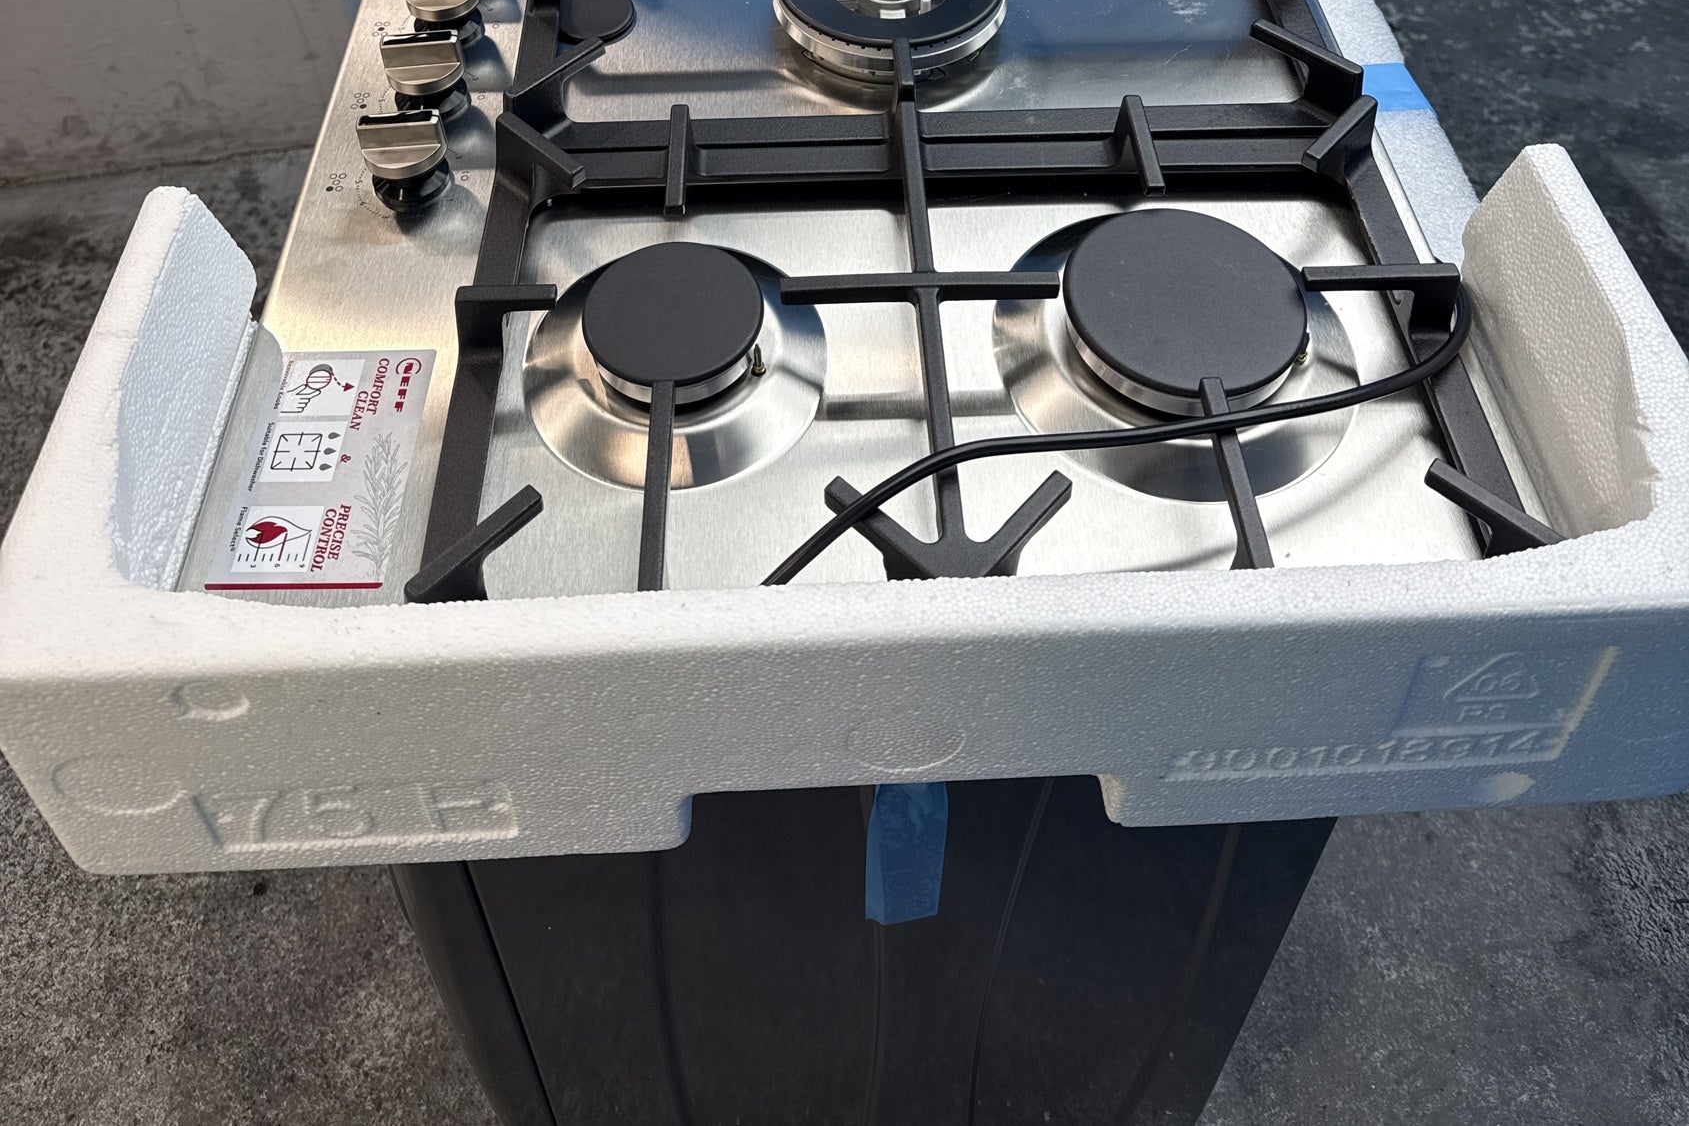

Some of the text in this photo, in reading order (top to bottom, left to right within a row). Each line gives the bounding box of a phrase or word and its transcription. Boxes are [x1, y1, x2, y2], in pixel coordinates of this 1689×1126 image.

[272, 393, 285, 410] Knobs
[349, 390, 369, 431] CLEAN
[365, 358, 390, 415] COMFORT
[394, 360, 416, 412] NEFF
[247, 422, 275, 492] Suitable for Dishwasher
[339, 453, 352, 463] &
[235, 506, 248, 524] Flame
[310, 508, 338, 573] CONTROL
[327, 503, 352, 561] PRECISE
